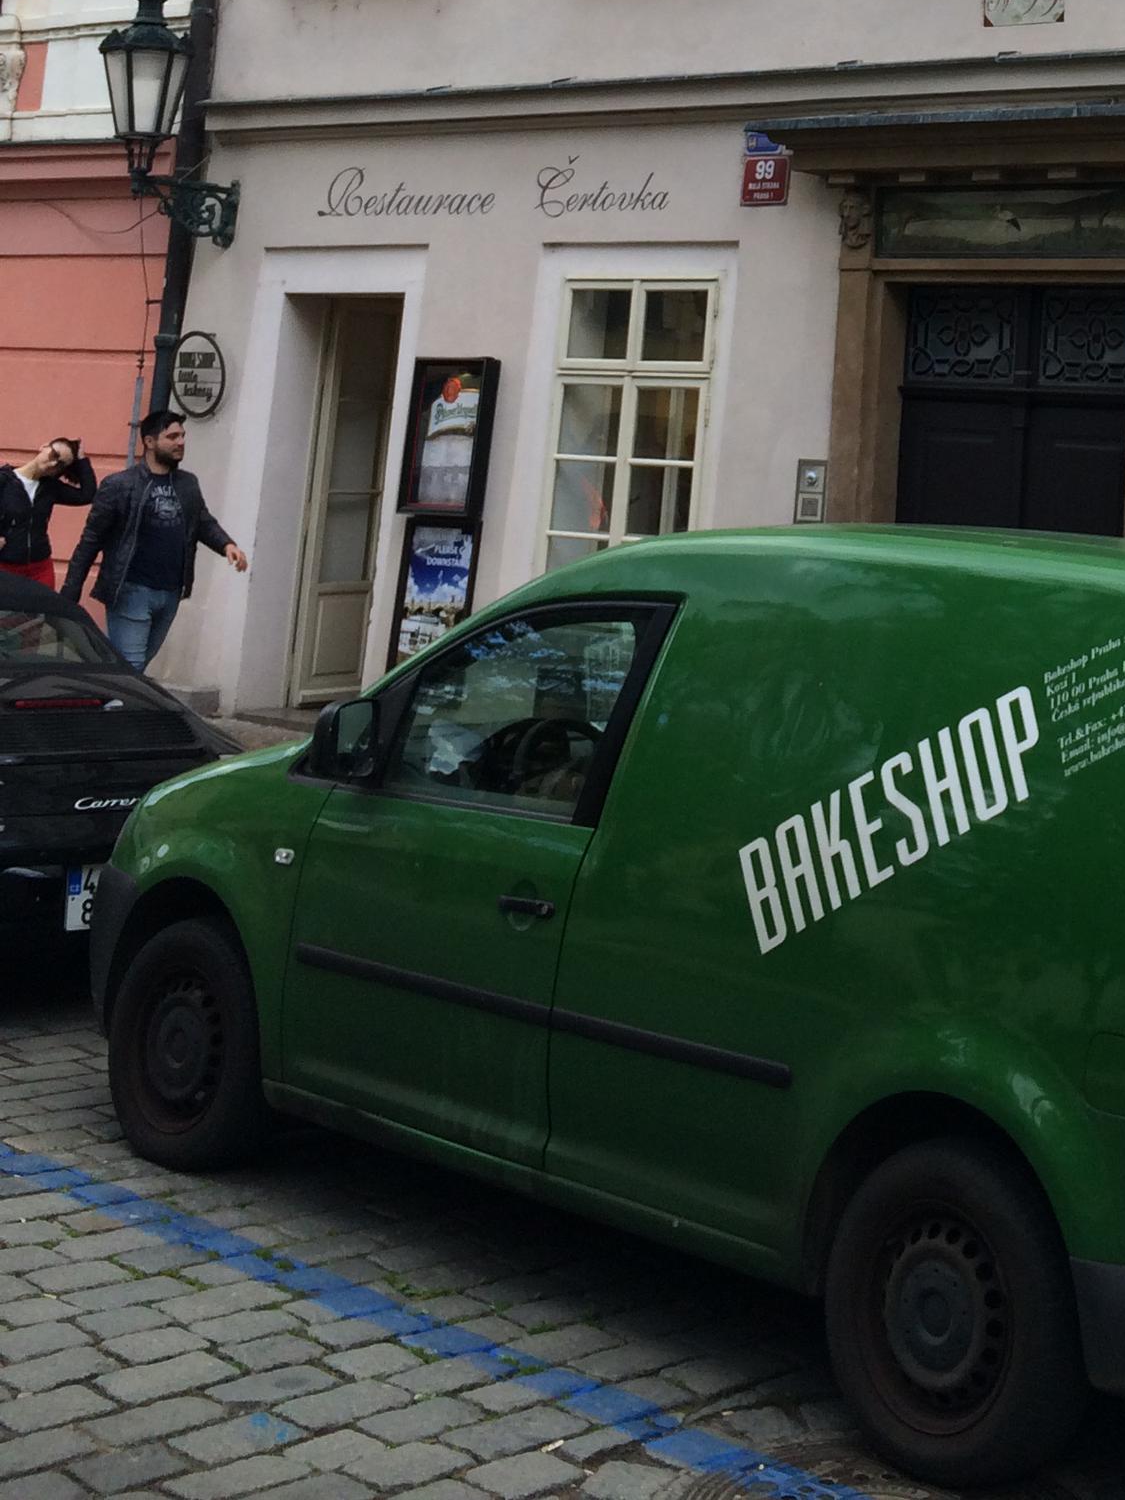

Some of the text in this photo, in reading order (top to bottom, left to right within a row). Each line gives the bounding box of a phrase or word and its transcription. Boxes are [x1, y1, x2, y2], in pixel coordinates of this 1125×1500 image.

[317, 155, 670, 218] Restaurace Čertovka
[755, 160, 775, 180] 99
[1044, 655, 1088, 684] Bakeshop
[1091, 638, 1121, 660] Praha
[1071, 672, 1077, 684] 1
[1050, 691, 1069, 709] 110
[1071, 683, 1086, 698] 00
[1088, 667, 1119, 690] Praha
[74, 796, 140, 810] Carrer
[739, 686, 1039, 955] BAKESHOP
